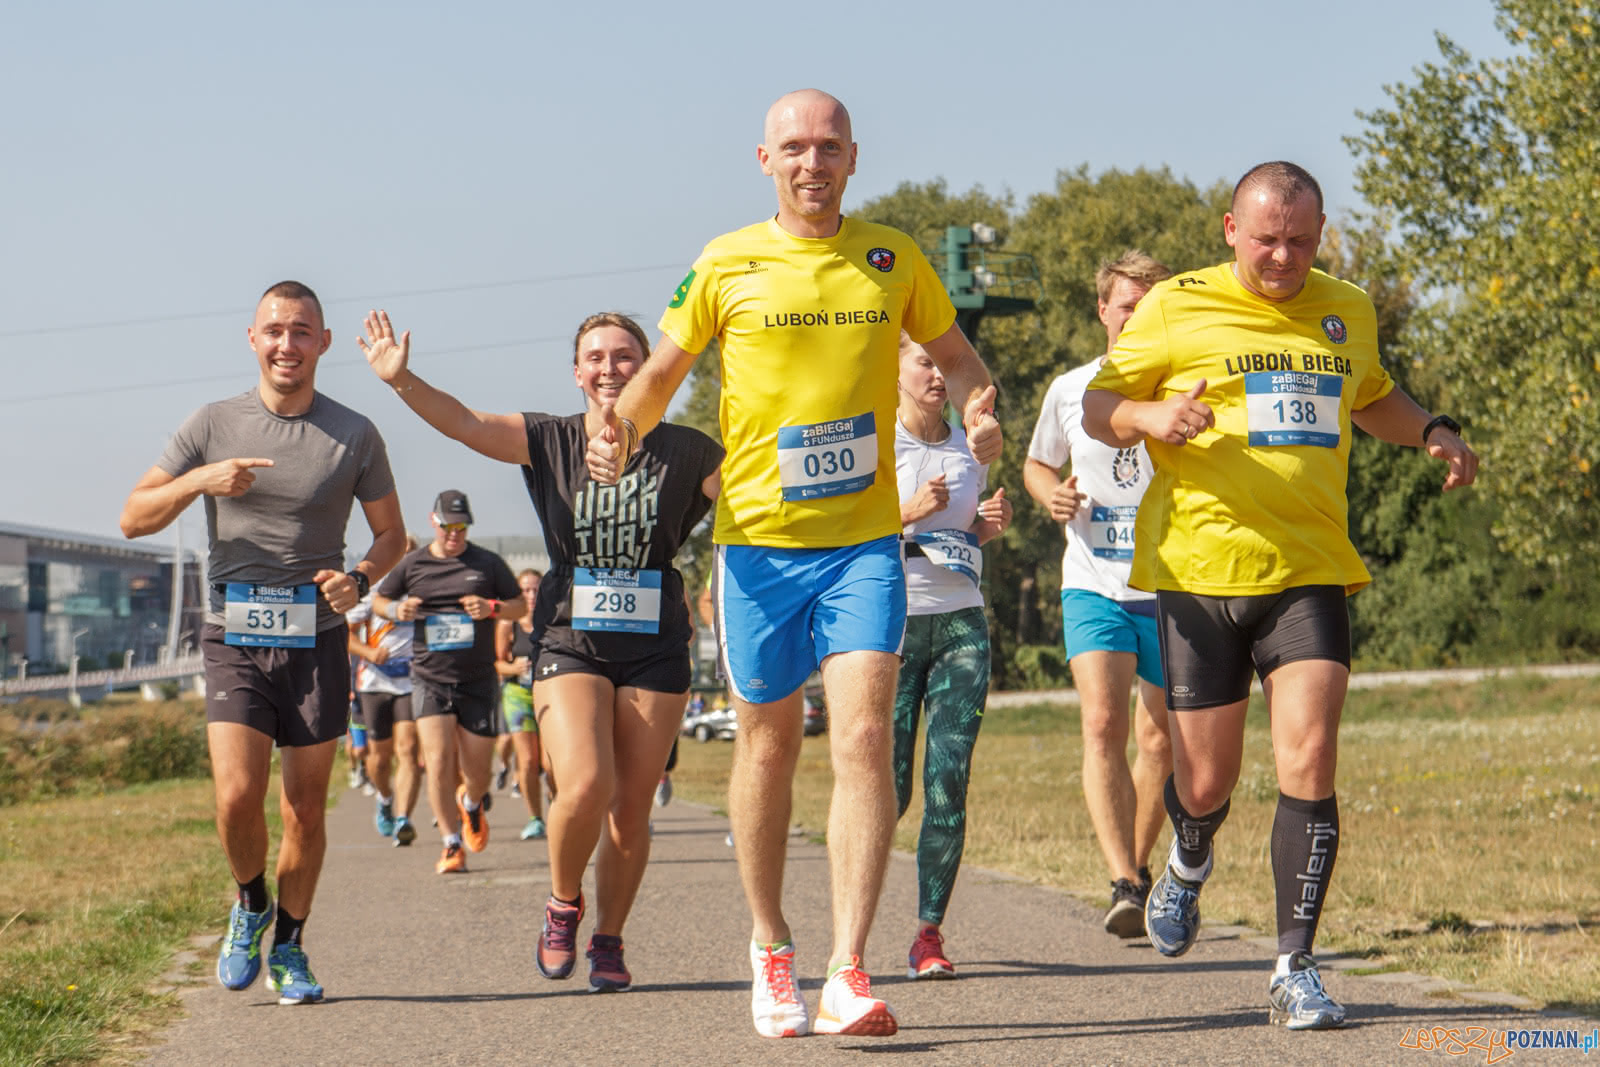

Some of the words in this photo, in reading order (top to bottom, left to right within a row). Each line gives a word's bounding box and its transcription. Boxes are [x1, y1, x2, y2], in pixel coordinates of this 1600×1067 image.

[765, 310, 828, 328] LUBOŃ
[835, 310, 890, 325] BIEGA
[1225, 350, 1293, 376] LUBOŃ
[1302, 354, 1352, 377] BIEGA
[1271, 373, 1318, 387] zaBIEGaj
[1272, 400, 1317, 424] 138
[802, 420, 853, 437] zaBIEGaj
[804, 448, 855, 477] 030
[941, 545, 974, 565] 222
[593, 592, 636, 614] 298
[247, 608, 288, 630] 531
